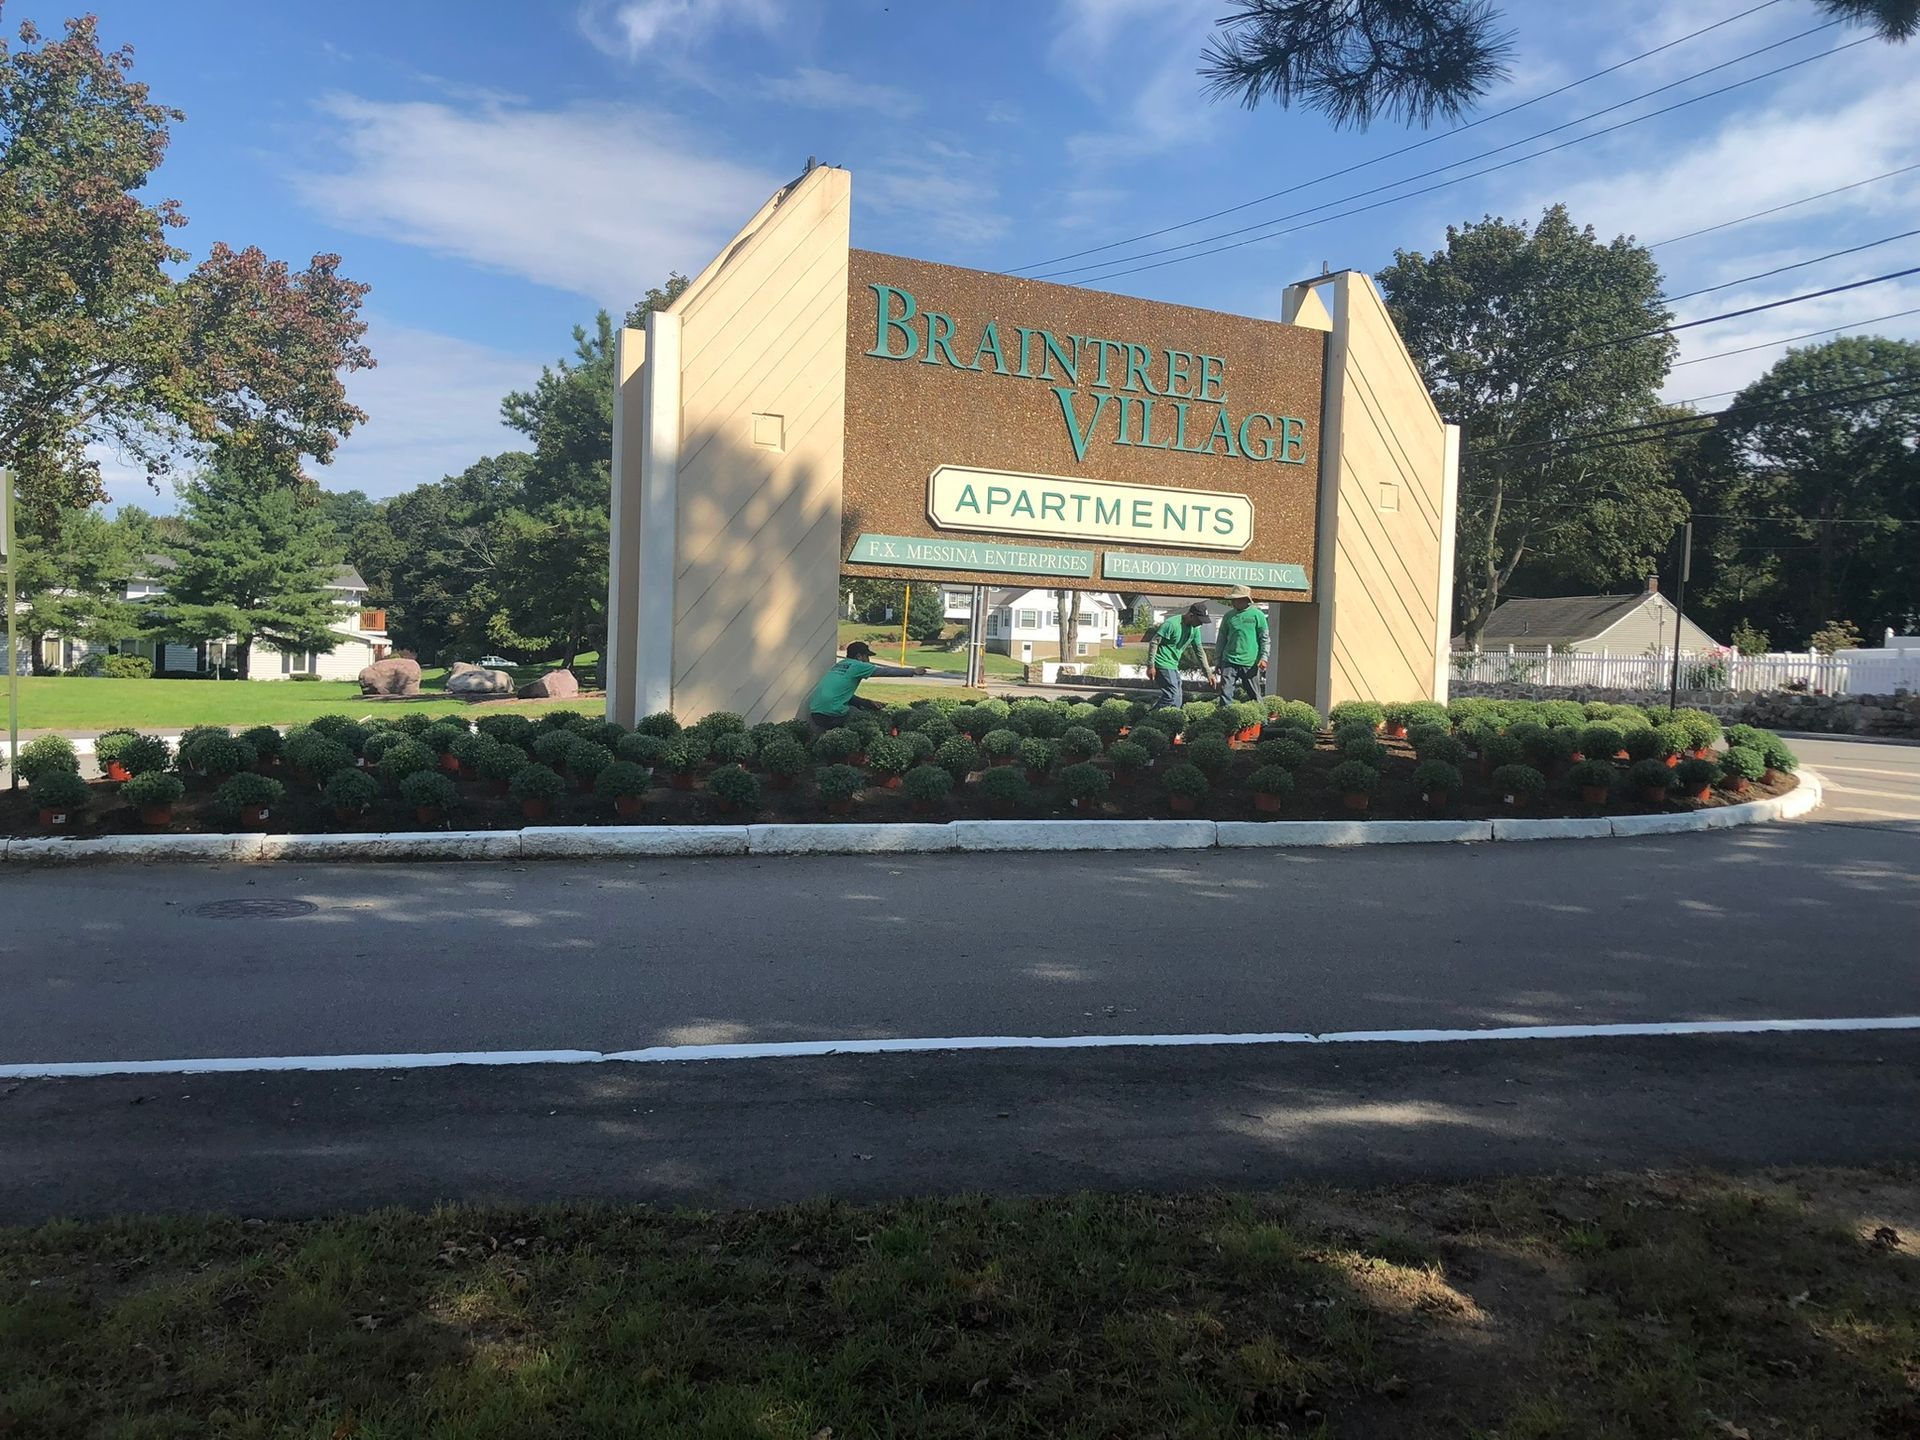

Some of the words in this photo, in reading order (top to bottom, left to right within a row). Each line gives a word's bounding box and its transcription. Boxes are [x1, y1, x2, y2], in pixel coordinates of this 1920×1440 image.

[865, 284, 1228, 404] BRAINTREE
[1050, 386, 1307, 465] VILLAGE
[955, 484, 1235, 536] APARTMENTS
[868, 541, 900, 559] F.X.
[906, 543, 978, 564] MESSINA
[984, 550, 1088, 571] ENTERPRISES
[1113, 558, 1180, 576] PEABODY
[1185, 563, 1264, 582] PROPERTIES
[1268, 569, 1295, 584] INC.
